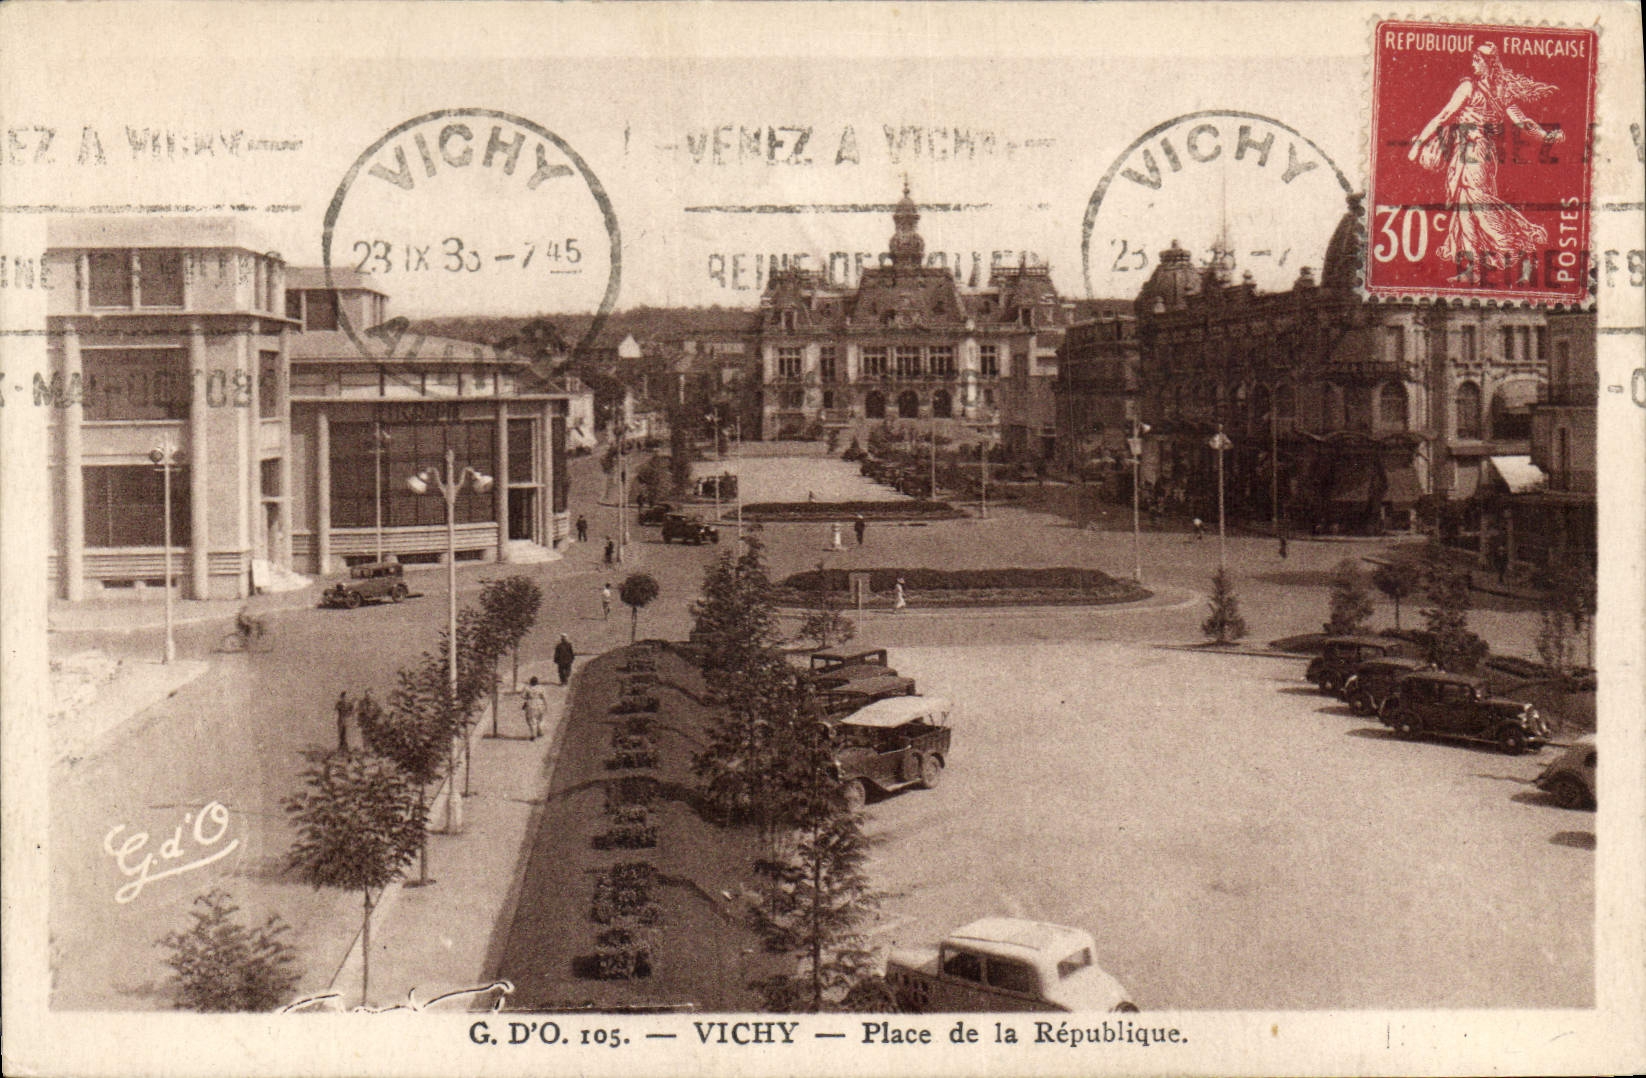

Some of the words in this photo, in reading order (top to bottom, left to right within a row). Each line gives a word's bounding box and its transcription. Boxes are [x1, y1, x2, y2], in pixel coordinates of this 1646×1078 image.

[1503, 36, 1586, 59] FRANÇAISE
[0, 125, 56, 165] EZ
[77, 125, 106, 165] A
[368, 123, 575, 190] VICHY
[685, 123, 813, 166] VENEZ
[834, 124, 860, 165] A
[883, 123, 997, 164] VICHY
[1120, 123, 1319, 190] VICHY
[352, 239, 392, 275] 23
[546, 238, 583, 274] 45
[1556, 195, 1580, 284] POSTES
